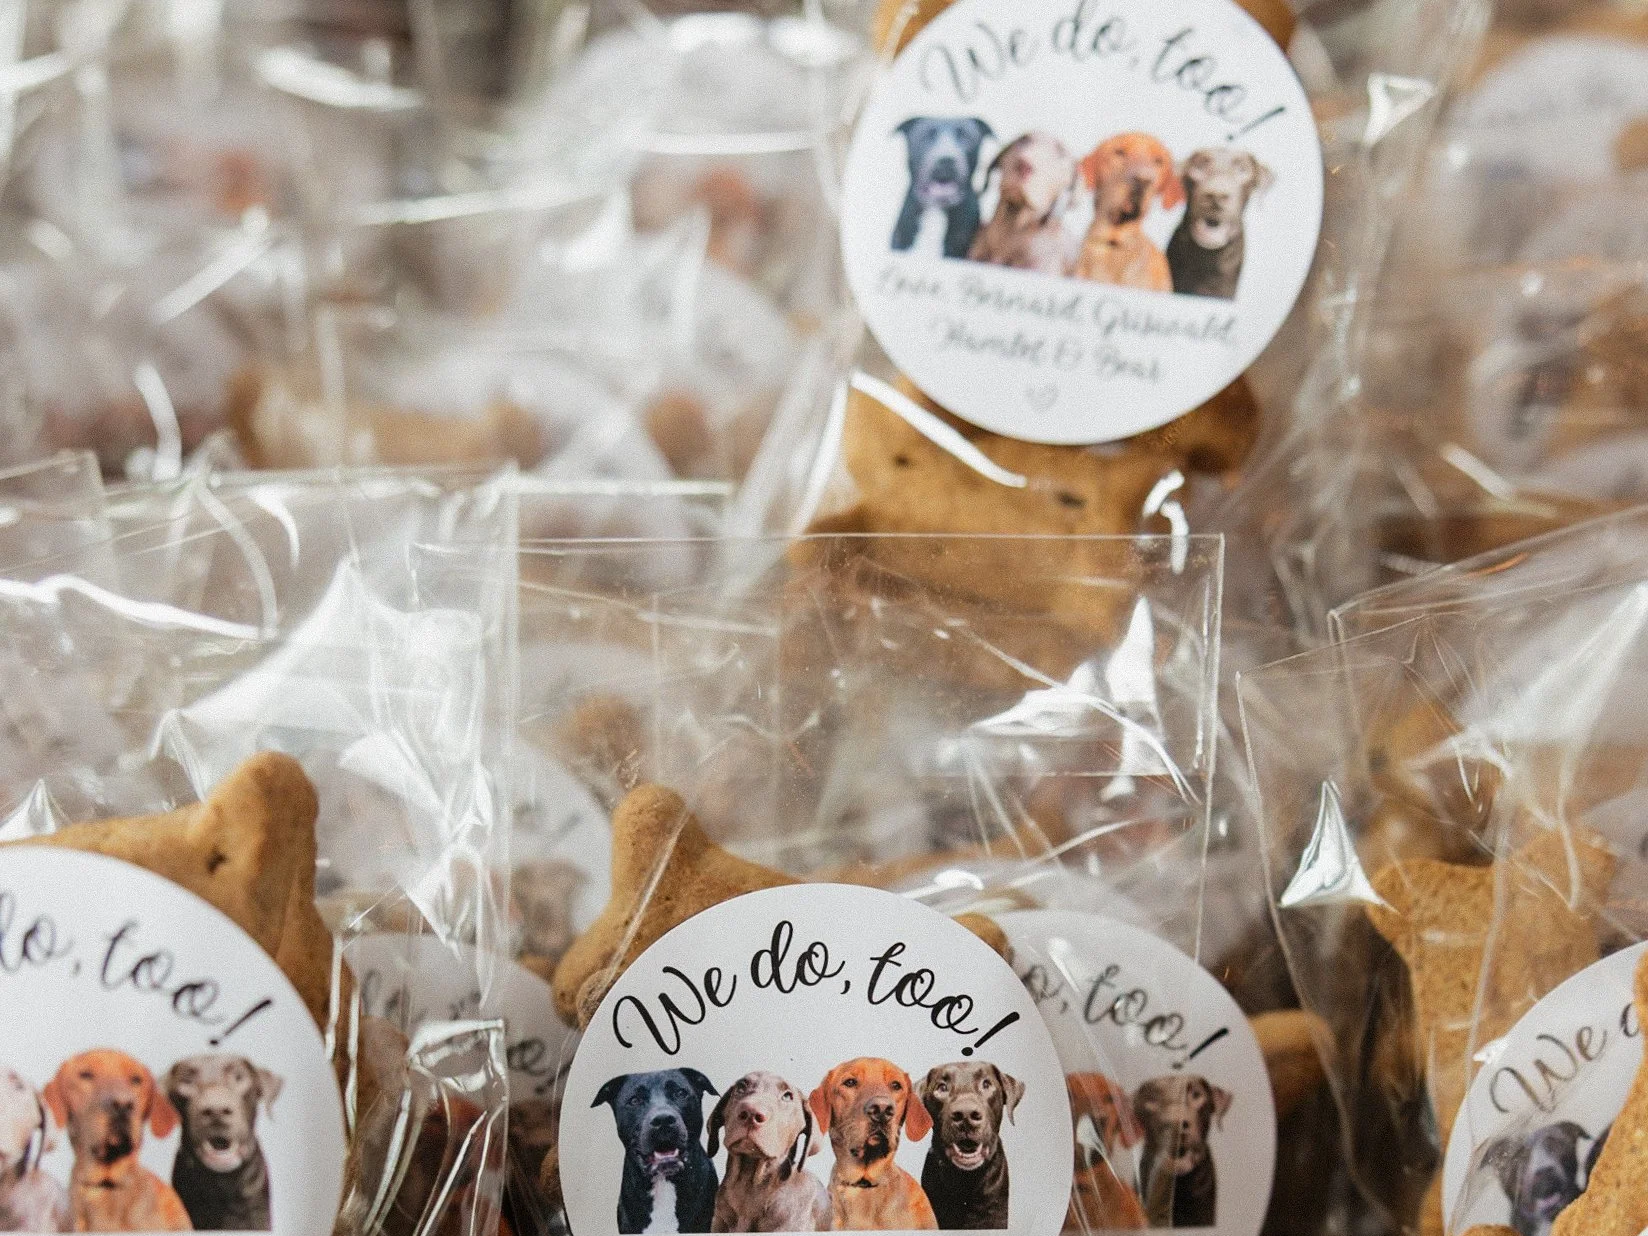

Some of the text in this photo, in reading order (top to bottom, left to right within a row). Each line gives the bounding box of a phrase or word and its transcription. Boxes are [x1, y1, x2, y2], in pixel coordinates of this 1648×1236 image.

[918, 22, 1038, 103] We
[1151, 27, 1286, 142] too!
[100, 919, 273, 1047] too!
[612, 965, 738, 1056] We
[750, 919, 851, 995] do,
[867, 941, 1021, 1057] too!
[1083, 964, 1229, 1070] too!
[1490, 1026, 1608, 1114] We
